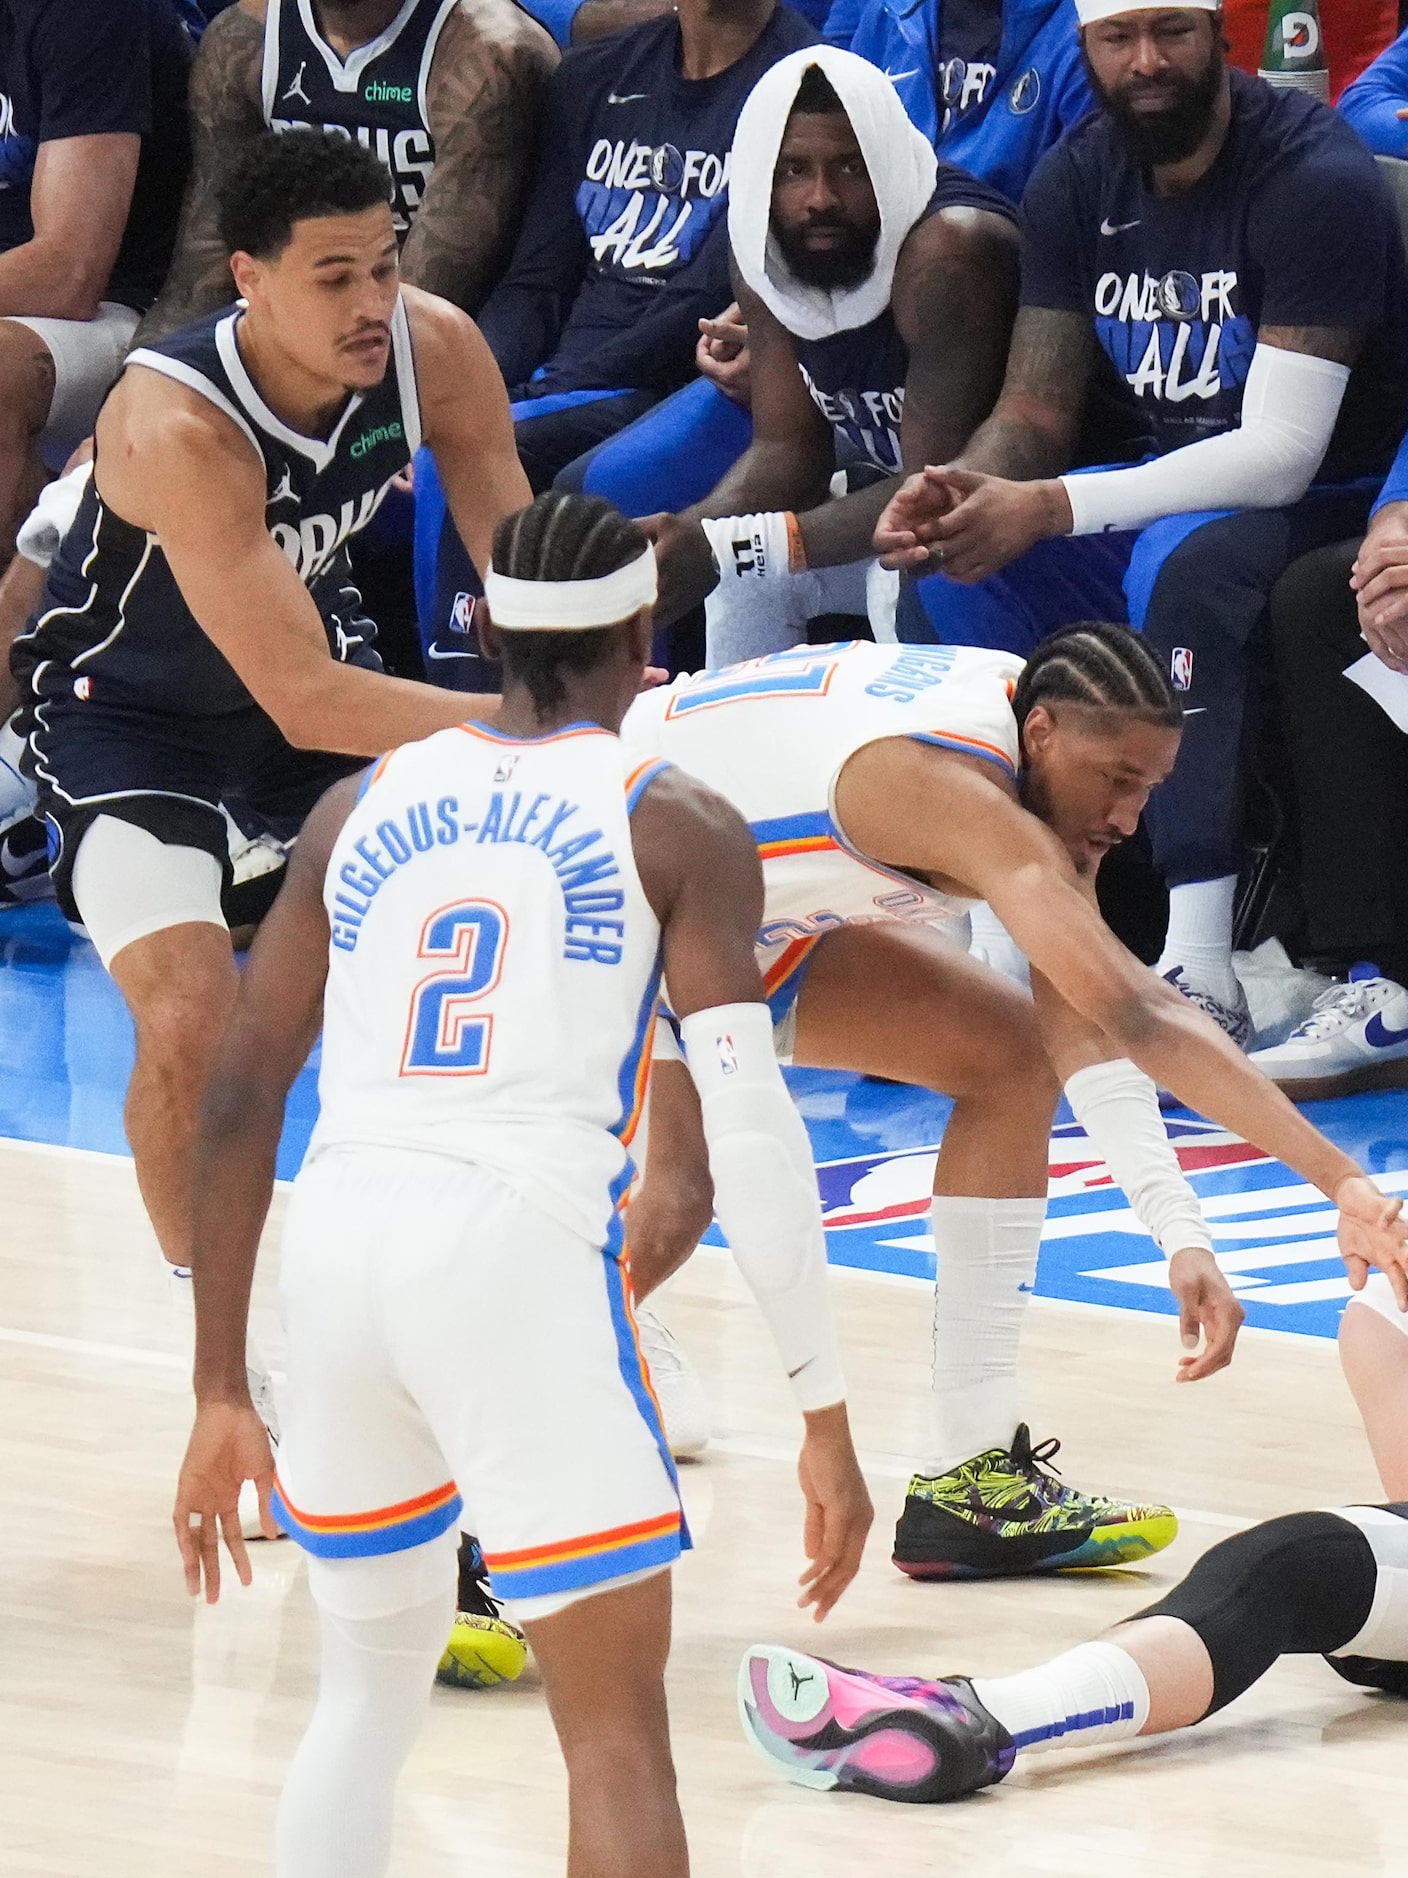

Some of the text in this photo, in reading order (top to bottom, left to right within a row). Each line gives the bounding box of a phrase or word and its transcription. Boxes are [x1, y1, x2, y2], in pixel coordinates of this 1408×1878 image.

[364, 80, 412, 102] chime
[586, 137, 653, 190] ONE
[589, 190, 680, 270] ALL
[1125, 321, 1222, 403] ALL
[350, 421, 402, 459] chime
[731, 539, 756, 578] 11
[331, 791, 625, 966] GILGEOUS-ALEXANDER
[400, 896, 510, 1077] 2
